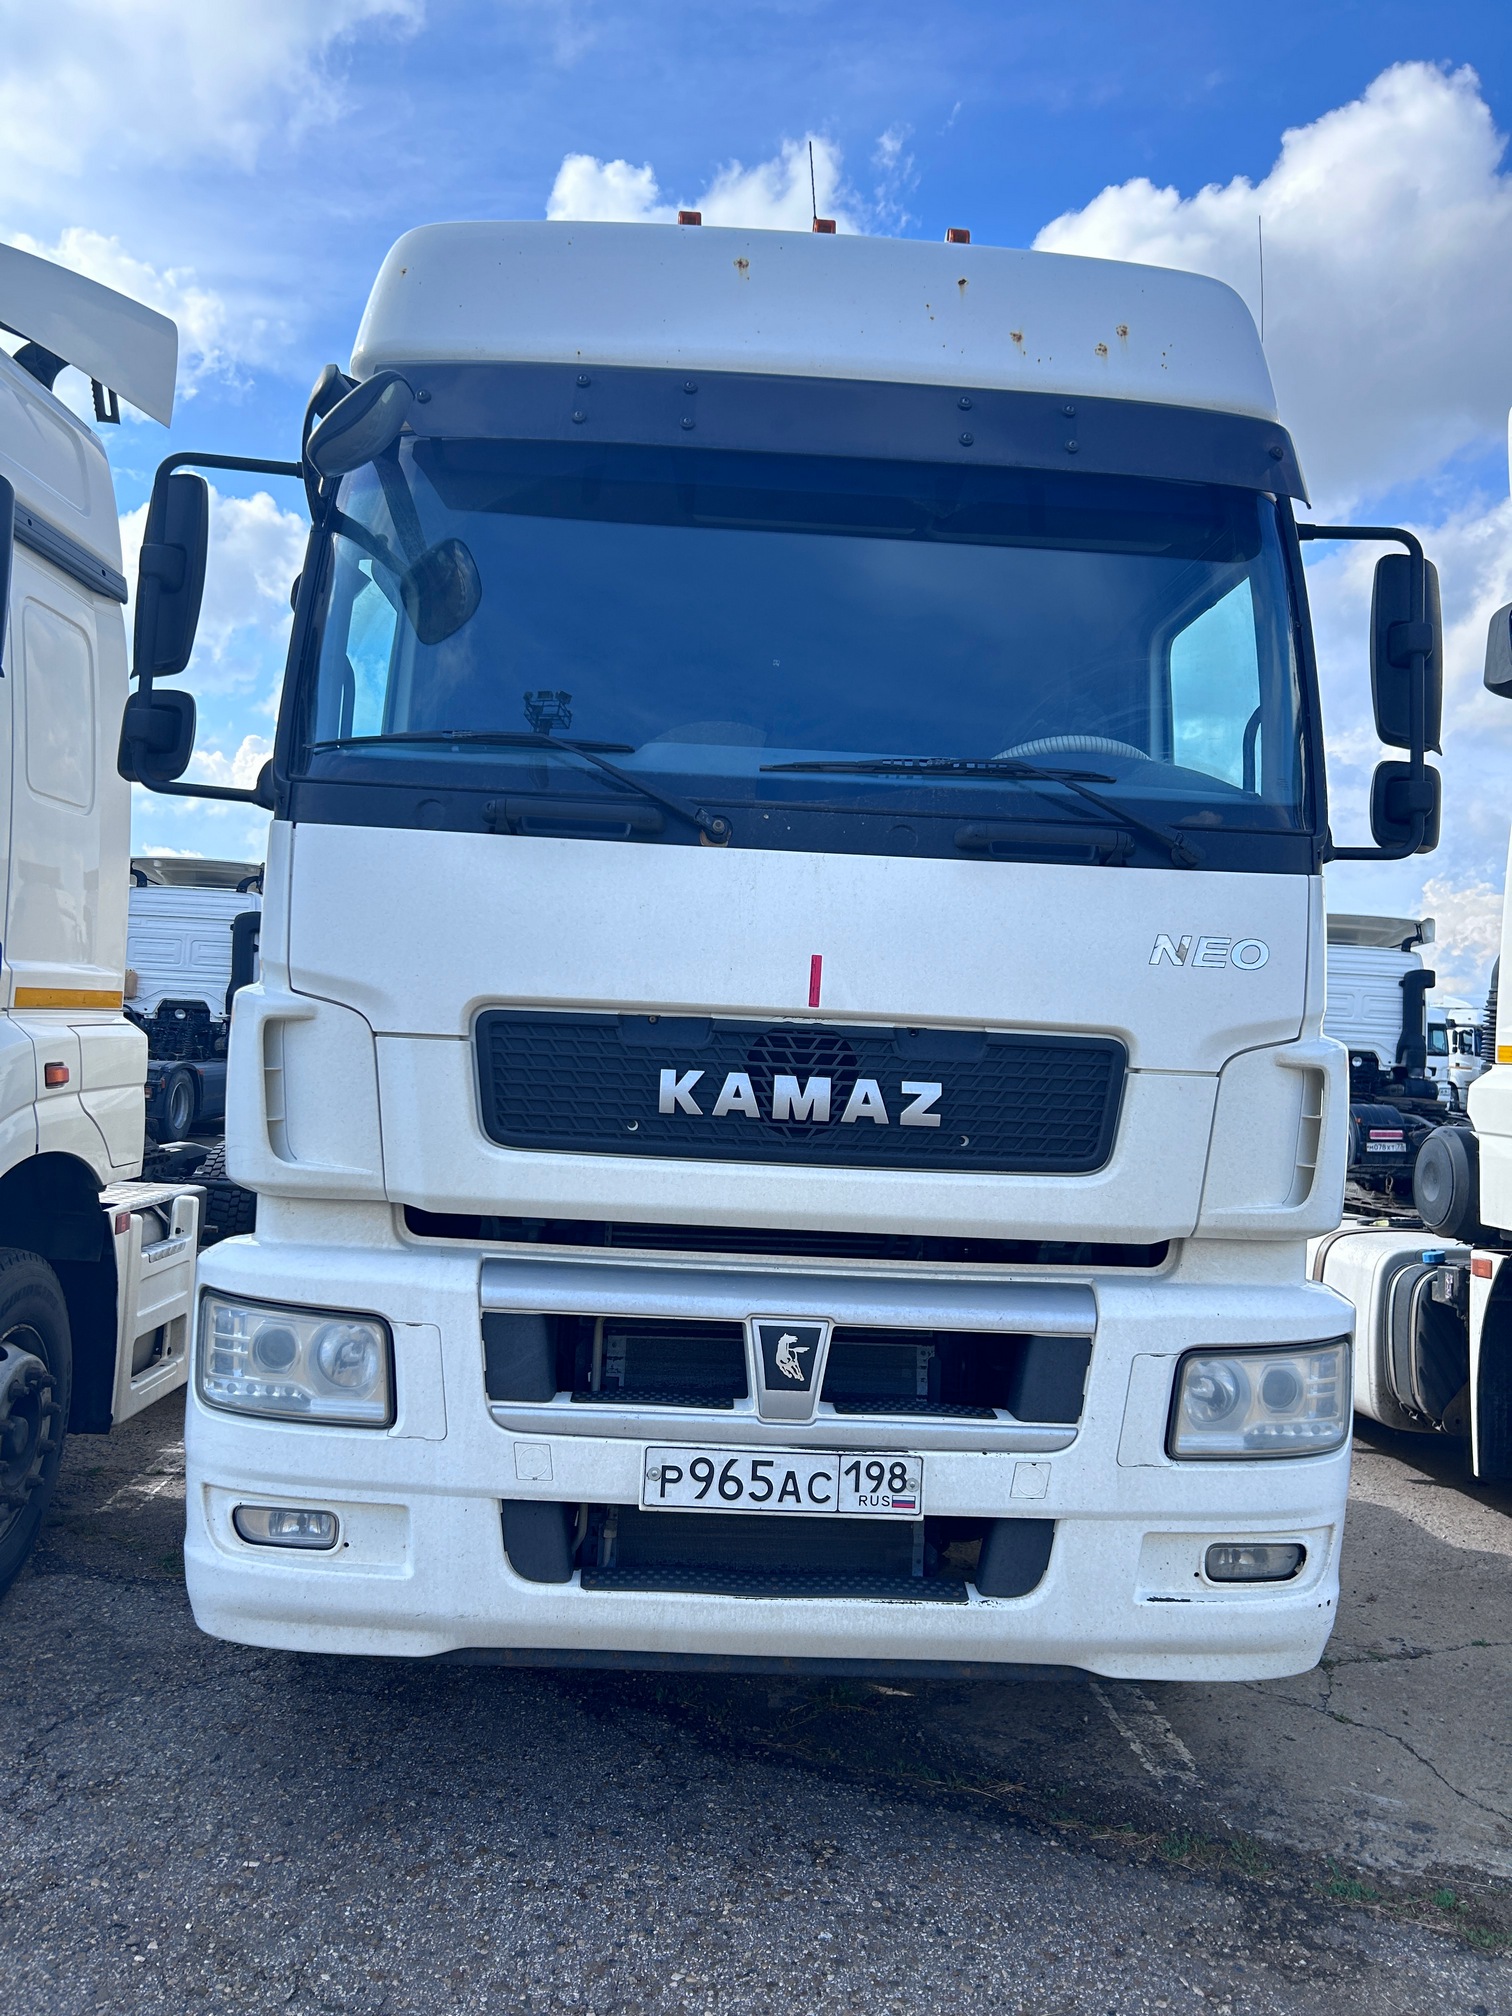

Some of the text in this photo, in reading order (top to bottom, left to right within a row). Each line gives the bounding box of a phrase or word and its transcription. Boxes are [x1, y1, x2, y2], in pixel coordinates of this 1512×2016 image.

[1148, 933, 1270, 971] NEO
[659, 1068, 942, 1127] KAMAZ
[660, 1457, 908, 1504] Р965АС 198
[857, 1494, 891, 1507] RUS
